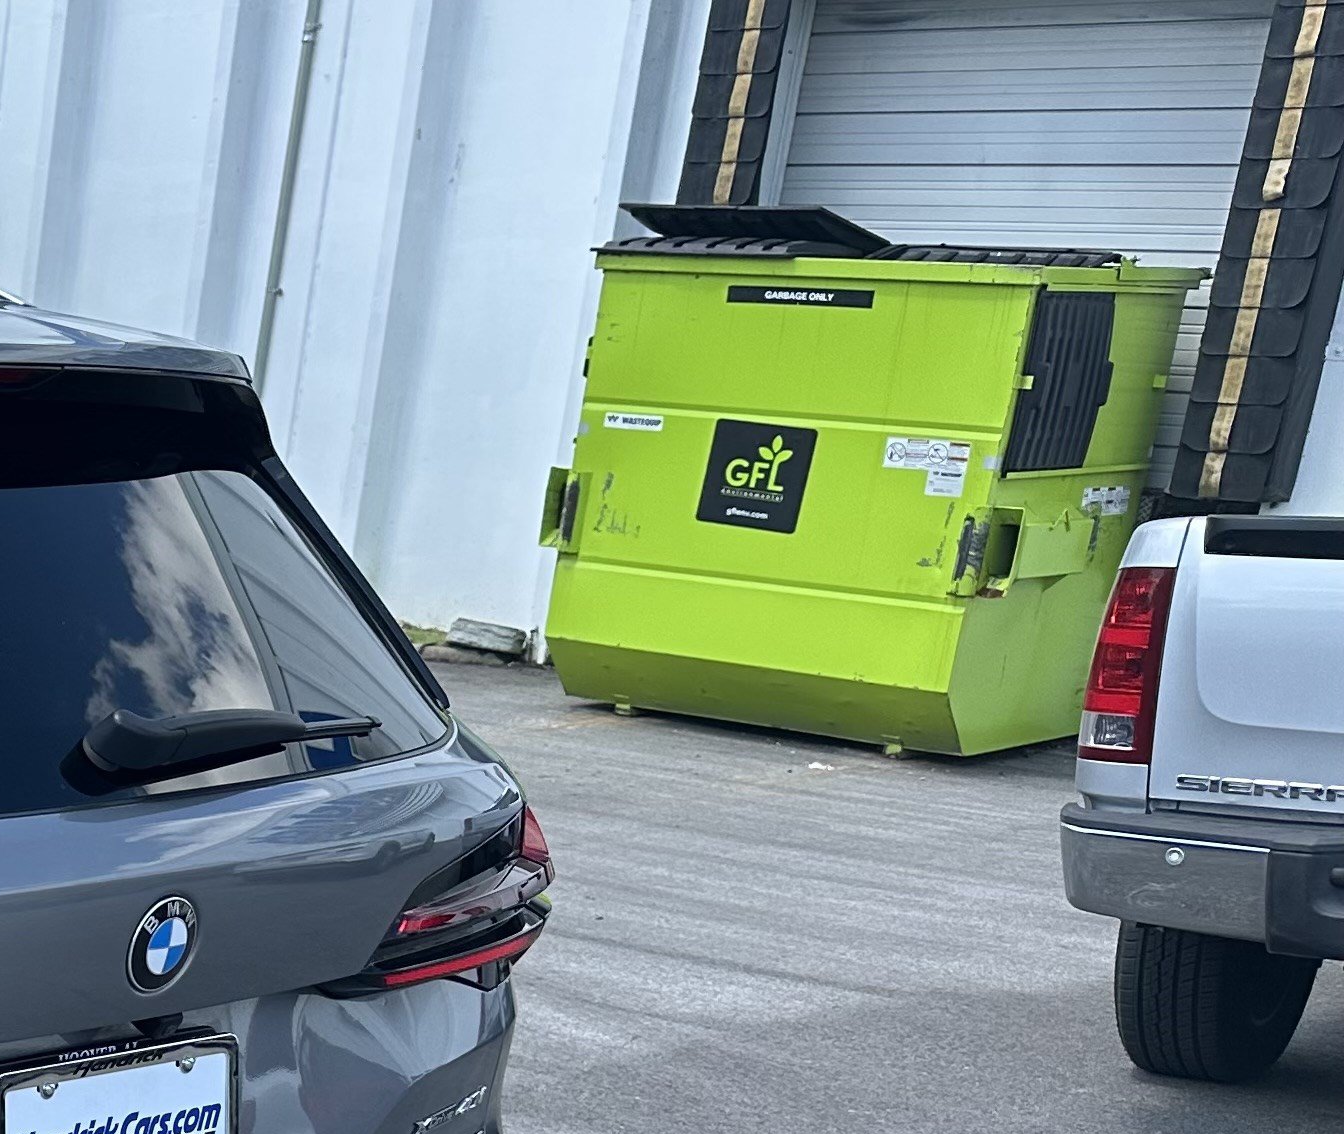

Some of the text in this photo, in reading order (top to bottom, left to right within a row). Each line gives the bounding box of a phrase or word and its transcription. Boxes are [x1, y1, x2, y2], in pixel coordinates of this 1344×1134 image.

[764, 290, 834, 302] GARBAGE ONLY
[725, 450, 785, 492] GFL
[143, 900, 196, 935] BMW
